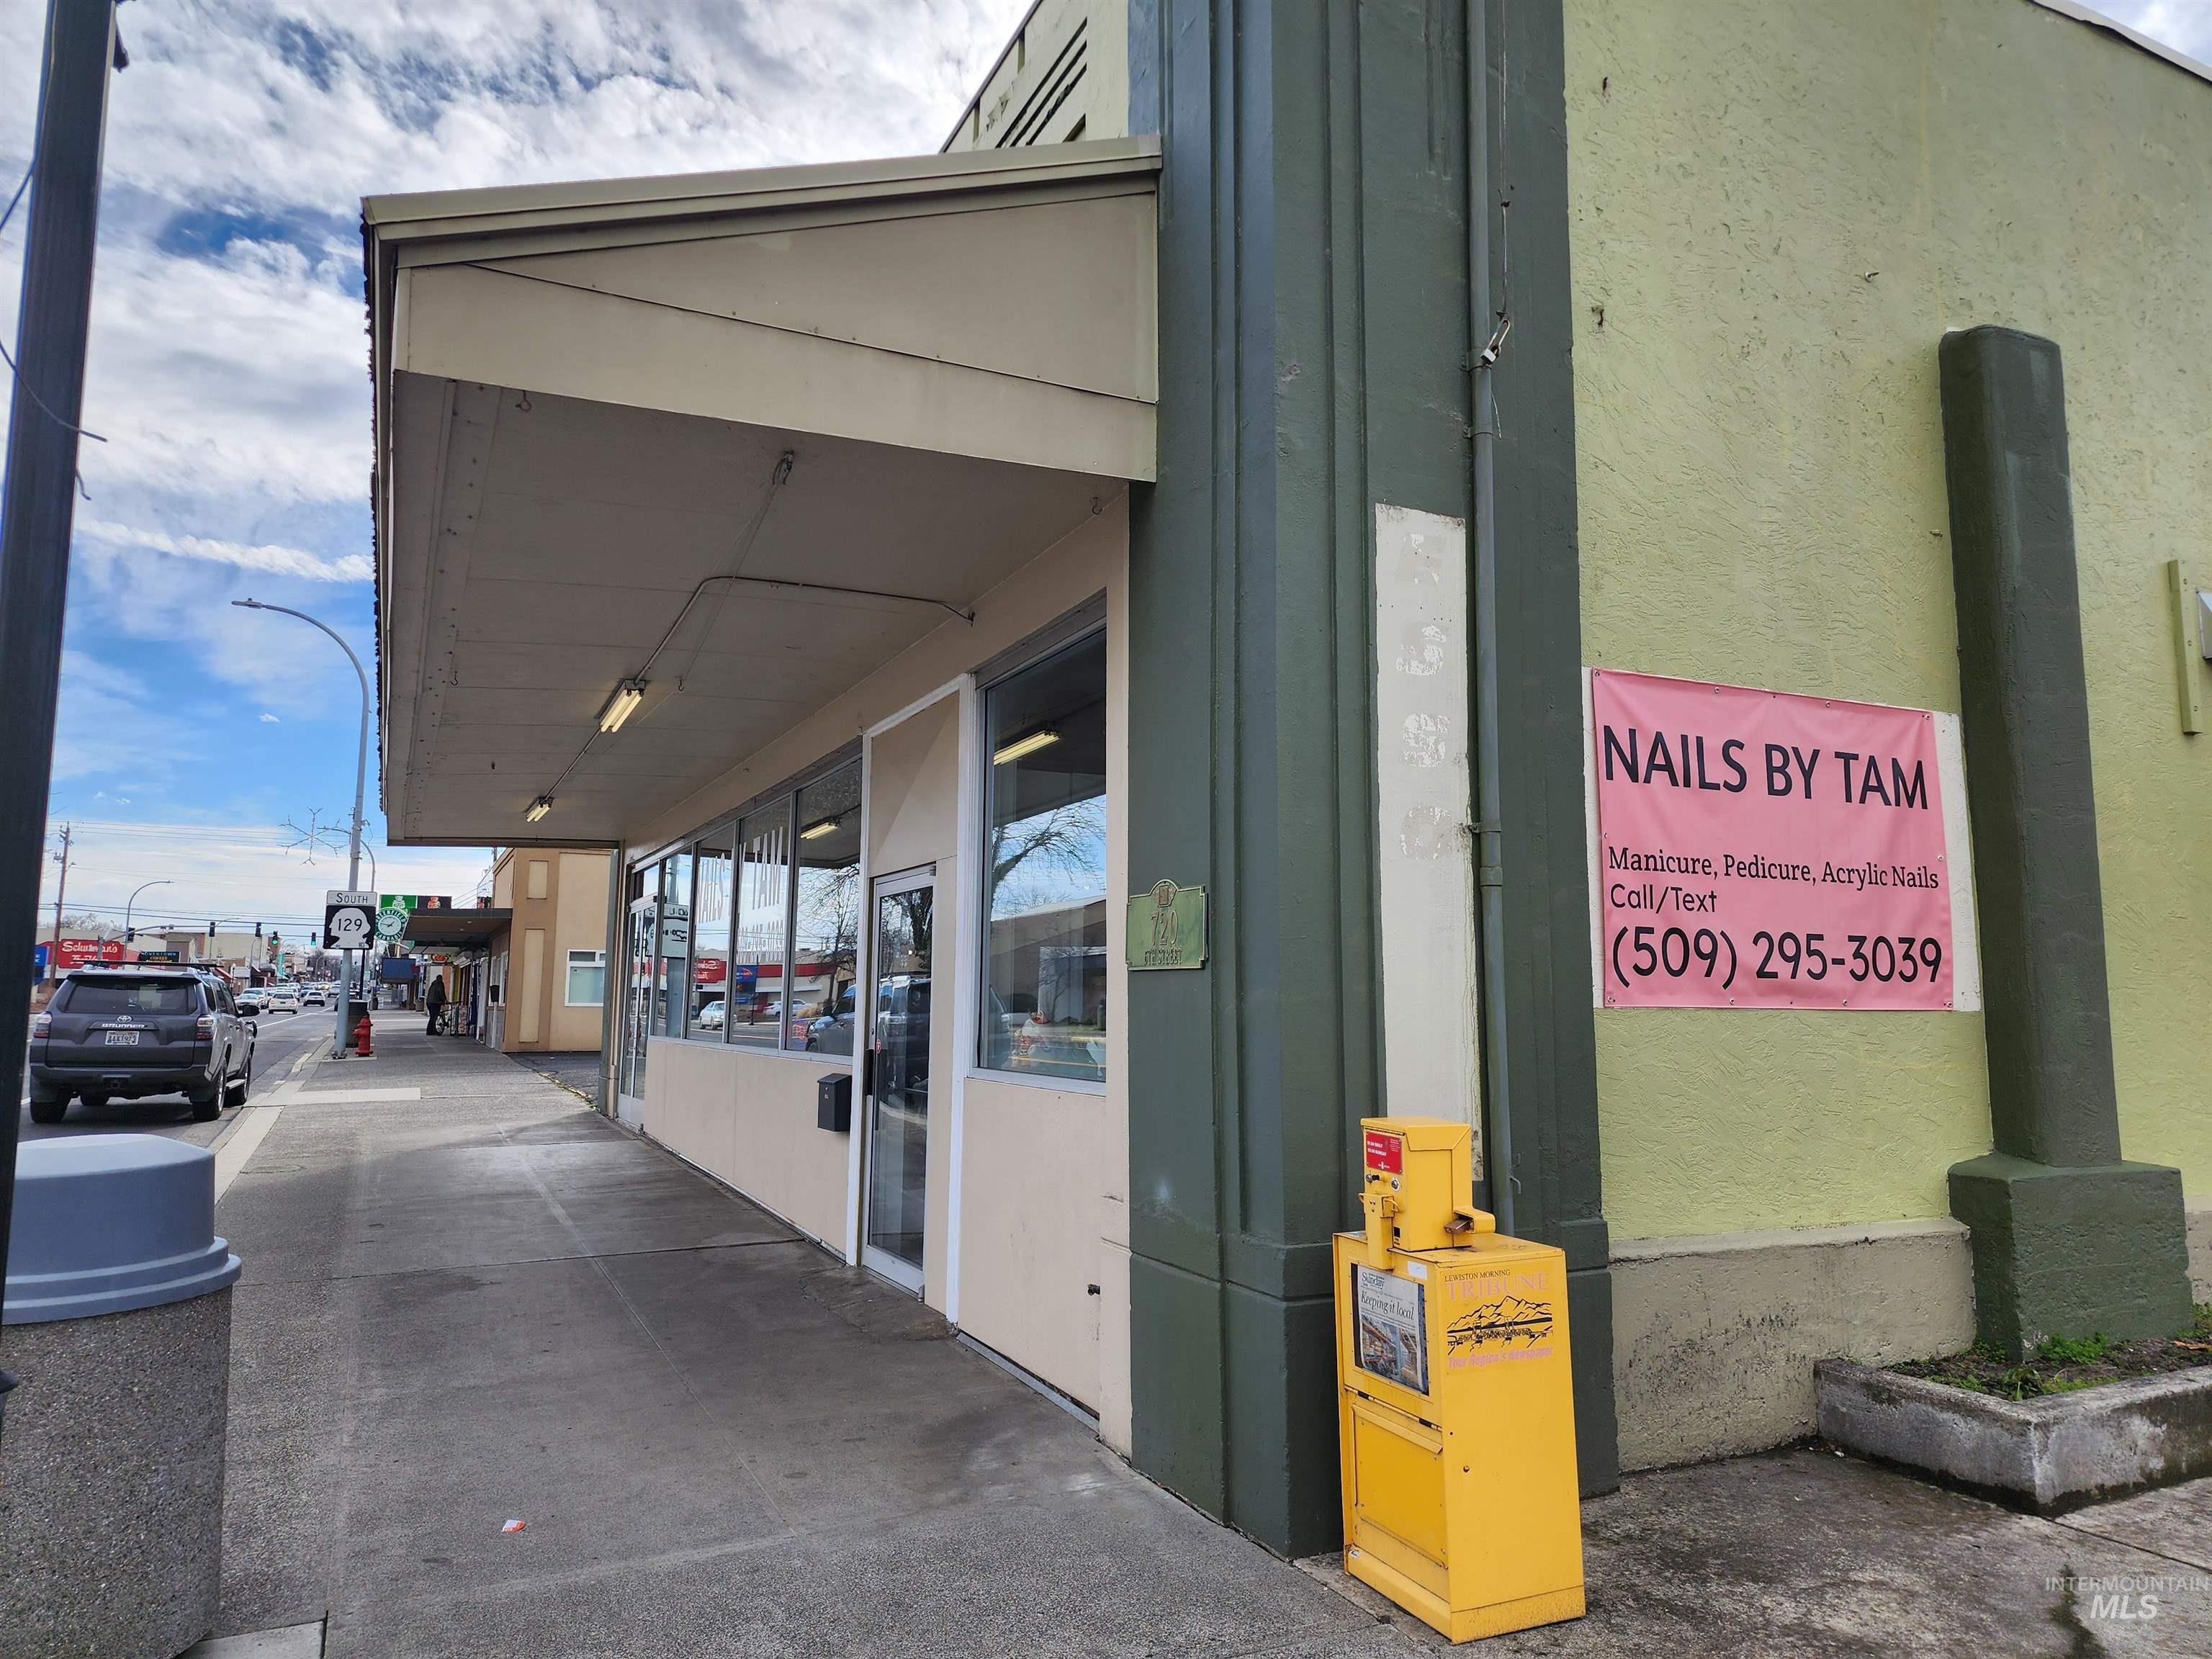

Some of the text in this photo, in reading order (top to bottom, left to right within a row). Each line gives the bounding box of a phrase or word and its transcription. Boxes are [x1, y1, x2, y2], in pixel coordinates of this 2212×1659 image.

[1604, 725, 1928, 810] NAILS BY TAM
[752, 826, 783, 911] TAM
[1609, 846, 1939, 891] Manicure, Pedicure, Acrylic Nails
[336, 892, 368, 904] SOUTH
[1610, 884, 1717, 914] Call/Text
[338, 918, 363, 932] 129
[1151, 909, 1179, 946] 720
[1613, 927, 1942, 989] (509) 295-3039
[1362, 1272, 1385, 1287] Sunday
[1444, 1269, 1511, 1282] LEWISTON MORNING
[1444, 1272, 1551, 1302] TRIBUNE
[1361, 1290, 1388, 1315] Keeping
[1390, 1300, 1395, 1314] it
[1396, 1301, 1414, 1321] local
[1447, 1357, 1466, 1369] Your
[1509, 1346, 1553, 1361] Newspaper
